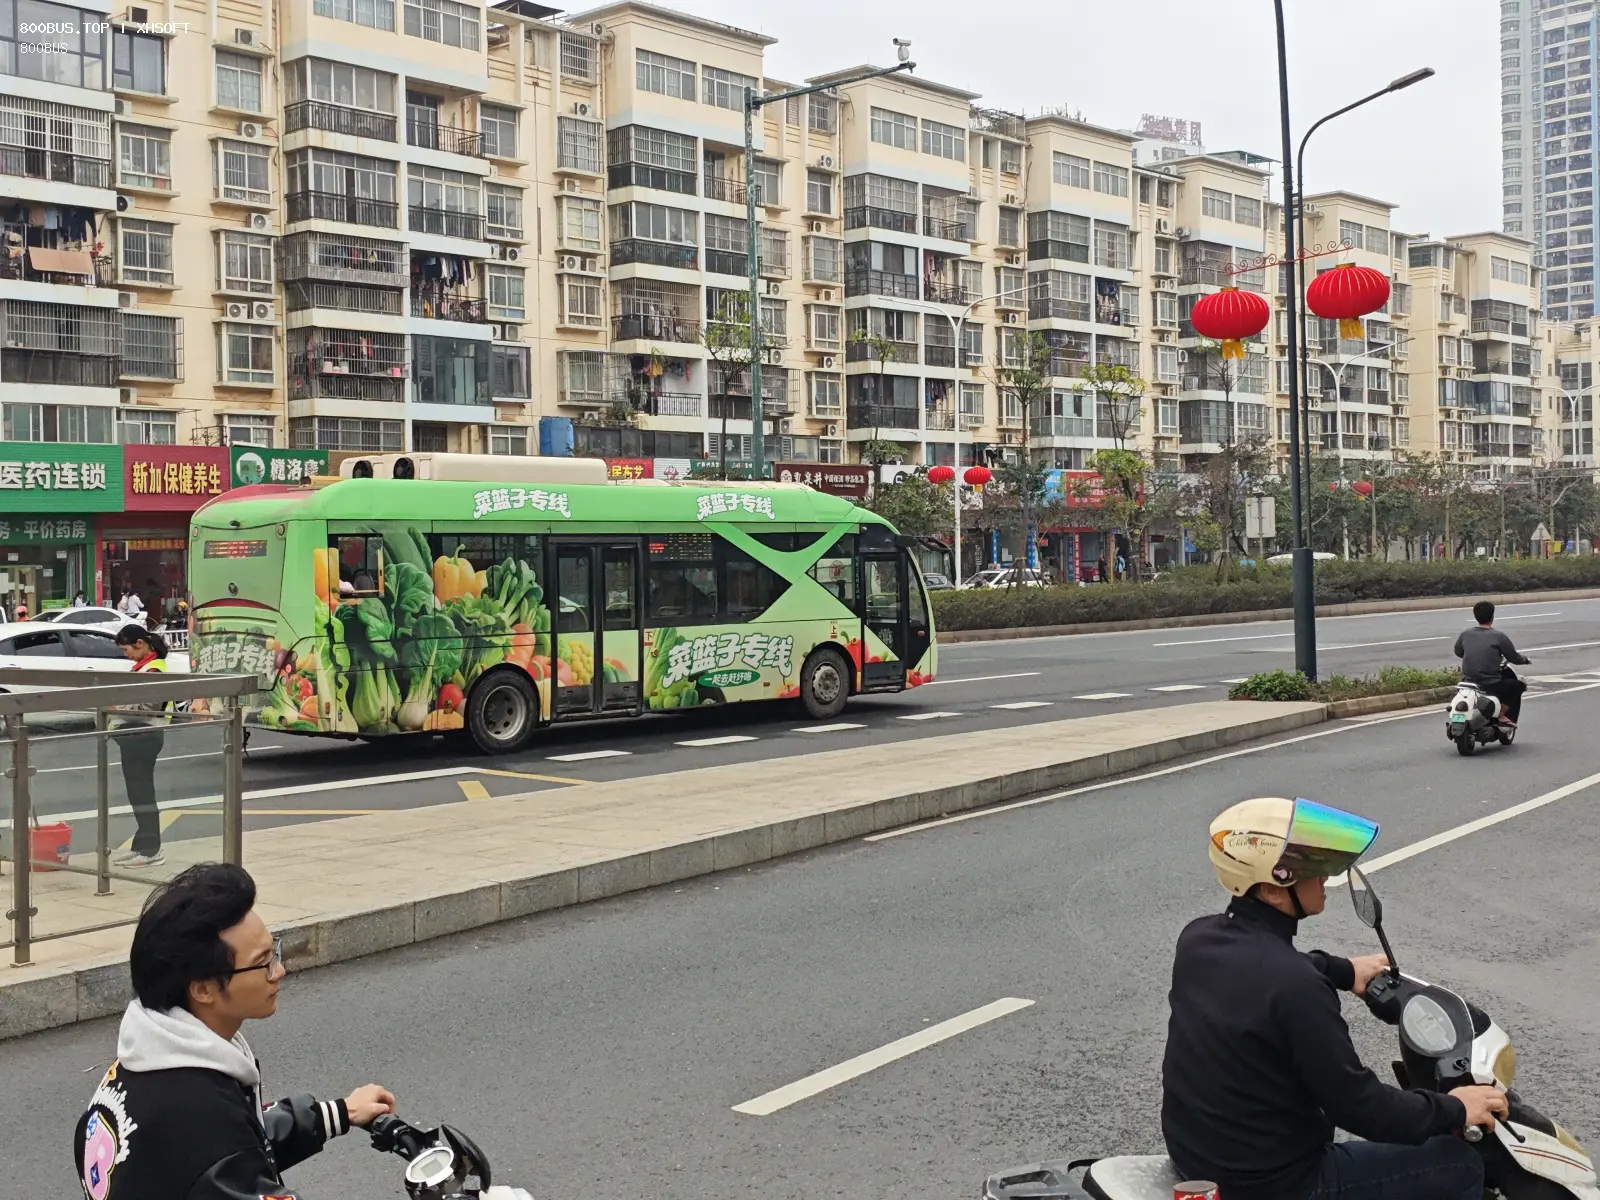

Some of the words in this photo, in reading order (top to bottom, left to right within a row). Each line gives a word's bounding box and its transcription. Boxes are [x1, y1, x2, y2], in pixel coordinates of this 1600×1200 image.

[0, 461, 106, 490] 医药连锁
[132, 461, 222, 495] 新加保健养生
[473, 488, 572, 520] 菜篮子专线
[696, 492, 776, 521] 菜篮子专线
[662, 633, 794, 689] 菜篮子专线
